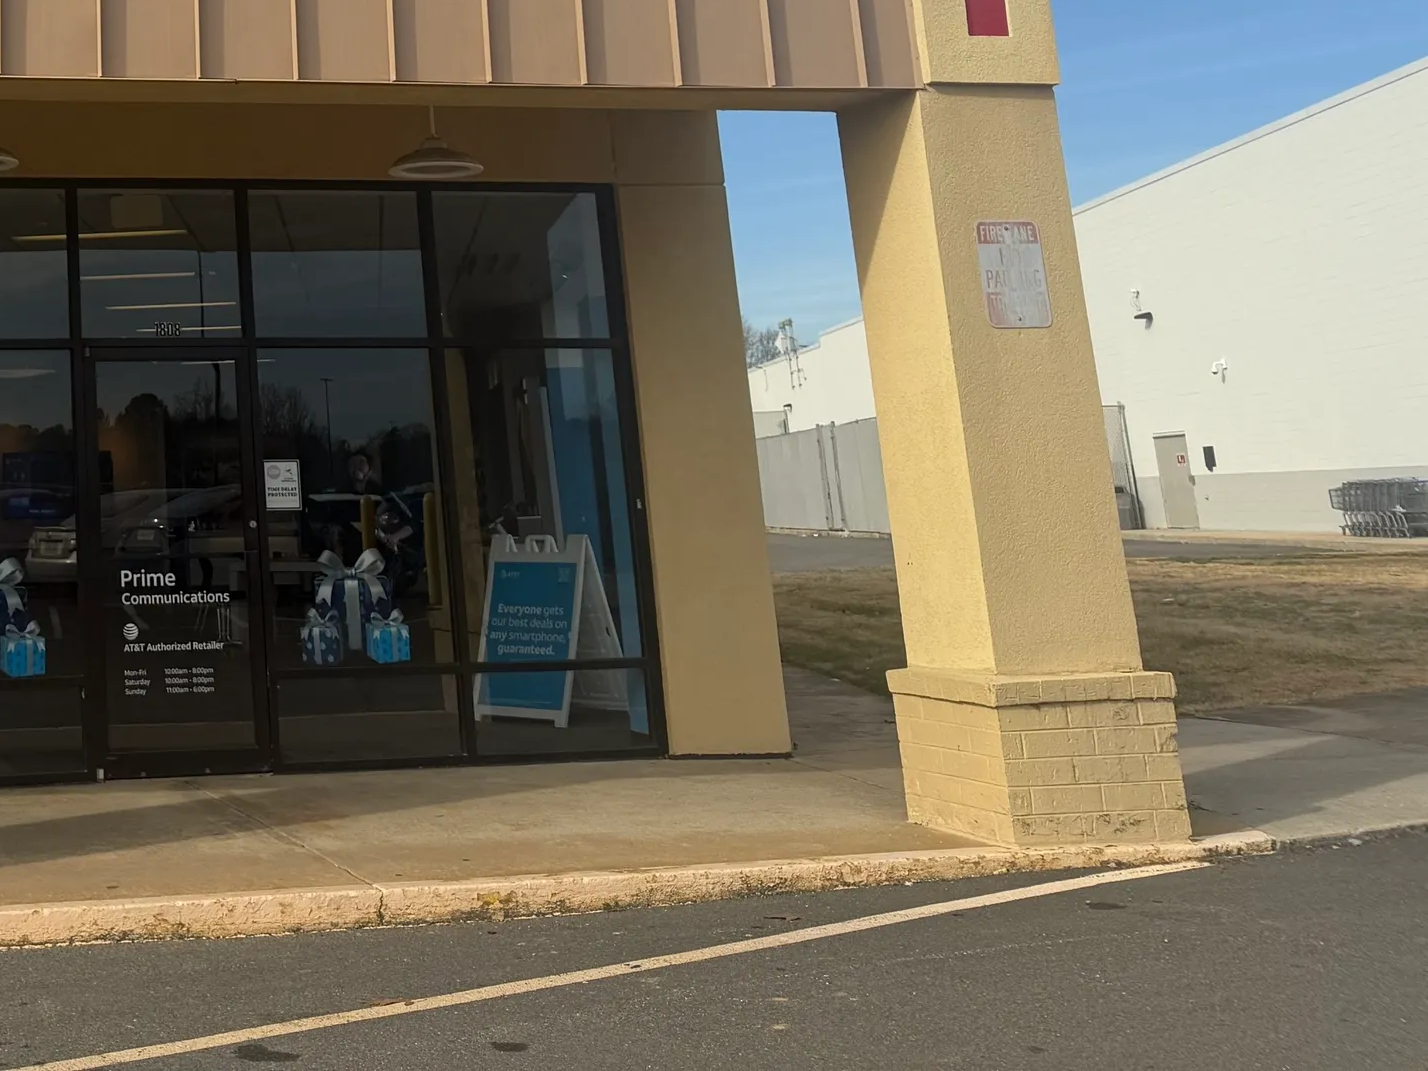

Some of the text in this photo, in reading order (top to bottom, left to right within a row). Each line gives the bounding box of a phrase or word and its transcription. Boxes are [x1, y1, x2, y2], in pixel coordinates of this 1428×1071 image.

[979, 225, 1004, 241] FIRE
[154, 322, 181, 337] 1808
[120, 569, 176, 587] Prime
[121, 591, 230, 605] Communications
[497, 603, 565, 617] Everyone gets
[491, 617, 568, 629] our best deals on
[489, 631, 507, 642] any
[123, 641, 225, 652] AT&T Authorized Retailer
[124, 678, 151, 686] Saturday
[125, 688, 147, 696] Sunday
